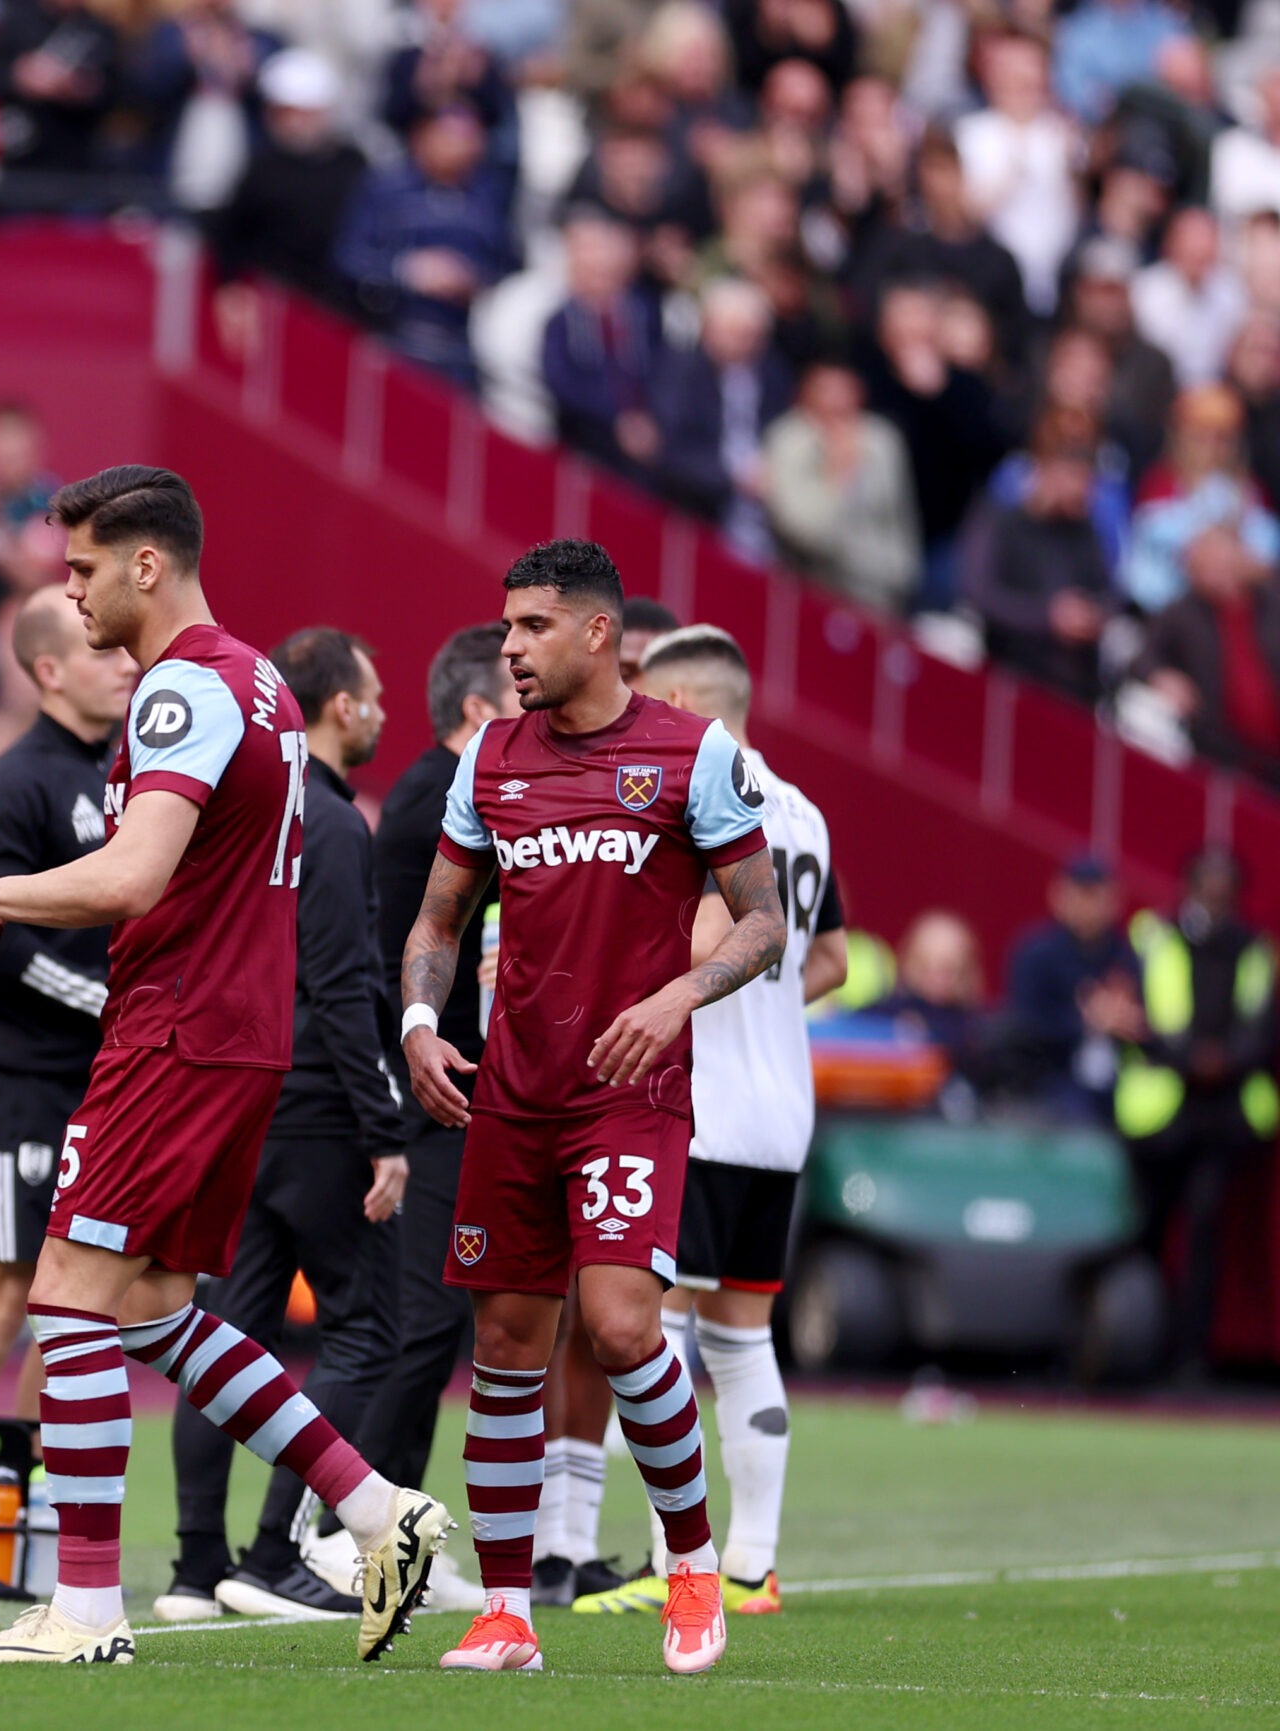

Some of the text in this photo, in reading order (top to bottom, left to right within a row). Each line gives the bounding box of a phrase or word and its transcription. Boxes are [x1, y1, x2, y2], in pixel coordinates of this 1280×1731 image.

[138, 703, 187, 736] JD
[491, 826, 660, 875] betway
[581, 1155, 655, 1220] 33
[598, 1233, 625, 1241] umbro
